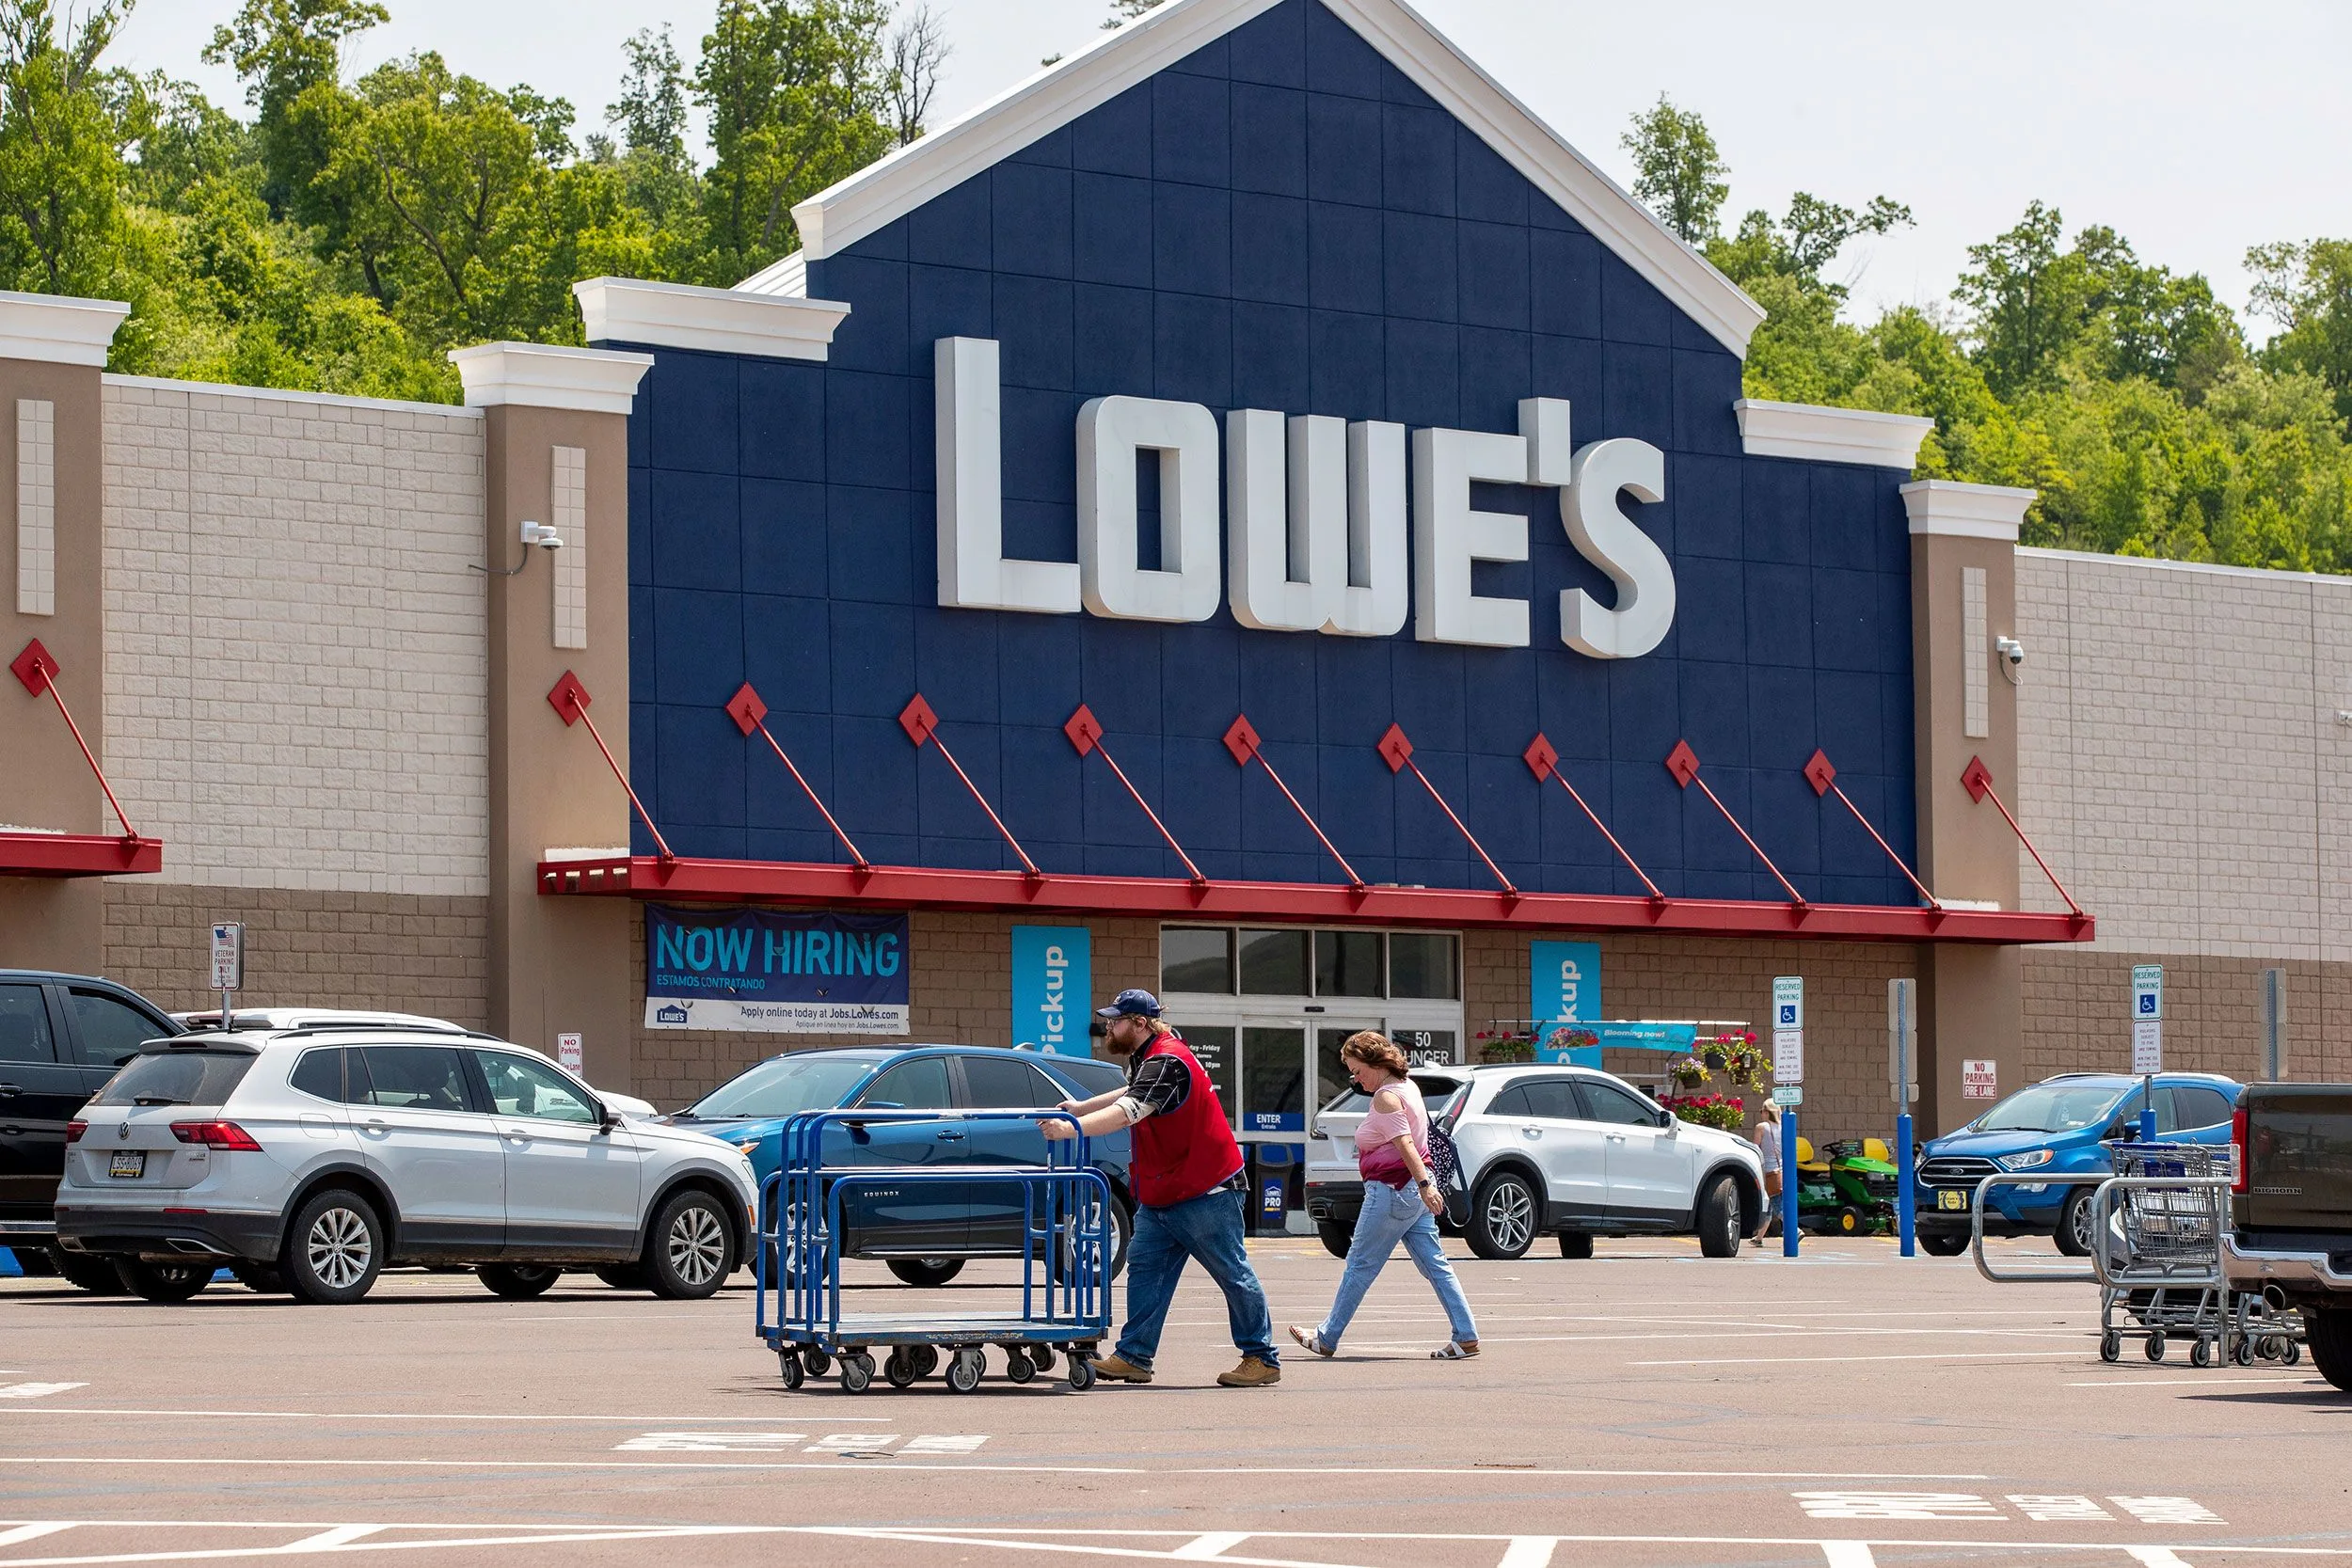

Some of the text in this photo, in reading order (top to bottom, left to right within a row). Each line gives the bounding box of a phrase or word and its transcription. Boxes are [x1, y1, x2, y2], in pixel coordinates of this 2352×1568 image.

[934, 336, 1677, 659] LOWE'S
[657, 925, 899, 977] NOW HIRING
[2135, 971, 2161, 979] RESERVED
[657, 974, 766, 990] ESTAMOS CONTRATANDO
[660, 1010, 685, 1022] LOWE'S
[740, 1006, 899, 1021] Apply online today at Jobs.Lowes.com
[1415, 1031, 1431, 1047] 50
[1604, 1029, 1644, 1039] Blooming
[561, 1046, 580, 1056] Parking
[1203, 1044, 1221, 1053] Friday
[1405, 1049, 1450, 1066] UNGER
[1974, 1063, 1985, 1072] NO
[1965, 1072, 1994, 1084] PARKING
[1965, 1085, 1995, 1096] FIRE LANE
[1256, 1114, 1281, 1124] ENTER
[2253, 1186, 2303, 1195] BIGHORN
[1264, 1197, 1281, 1207] PRO
